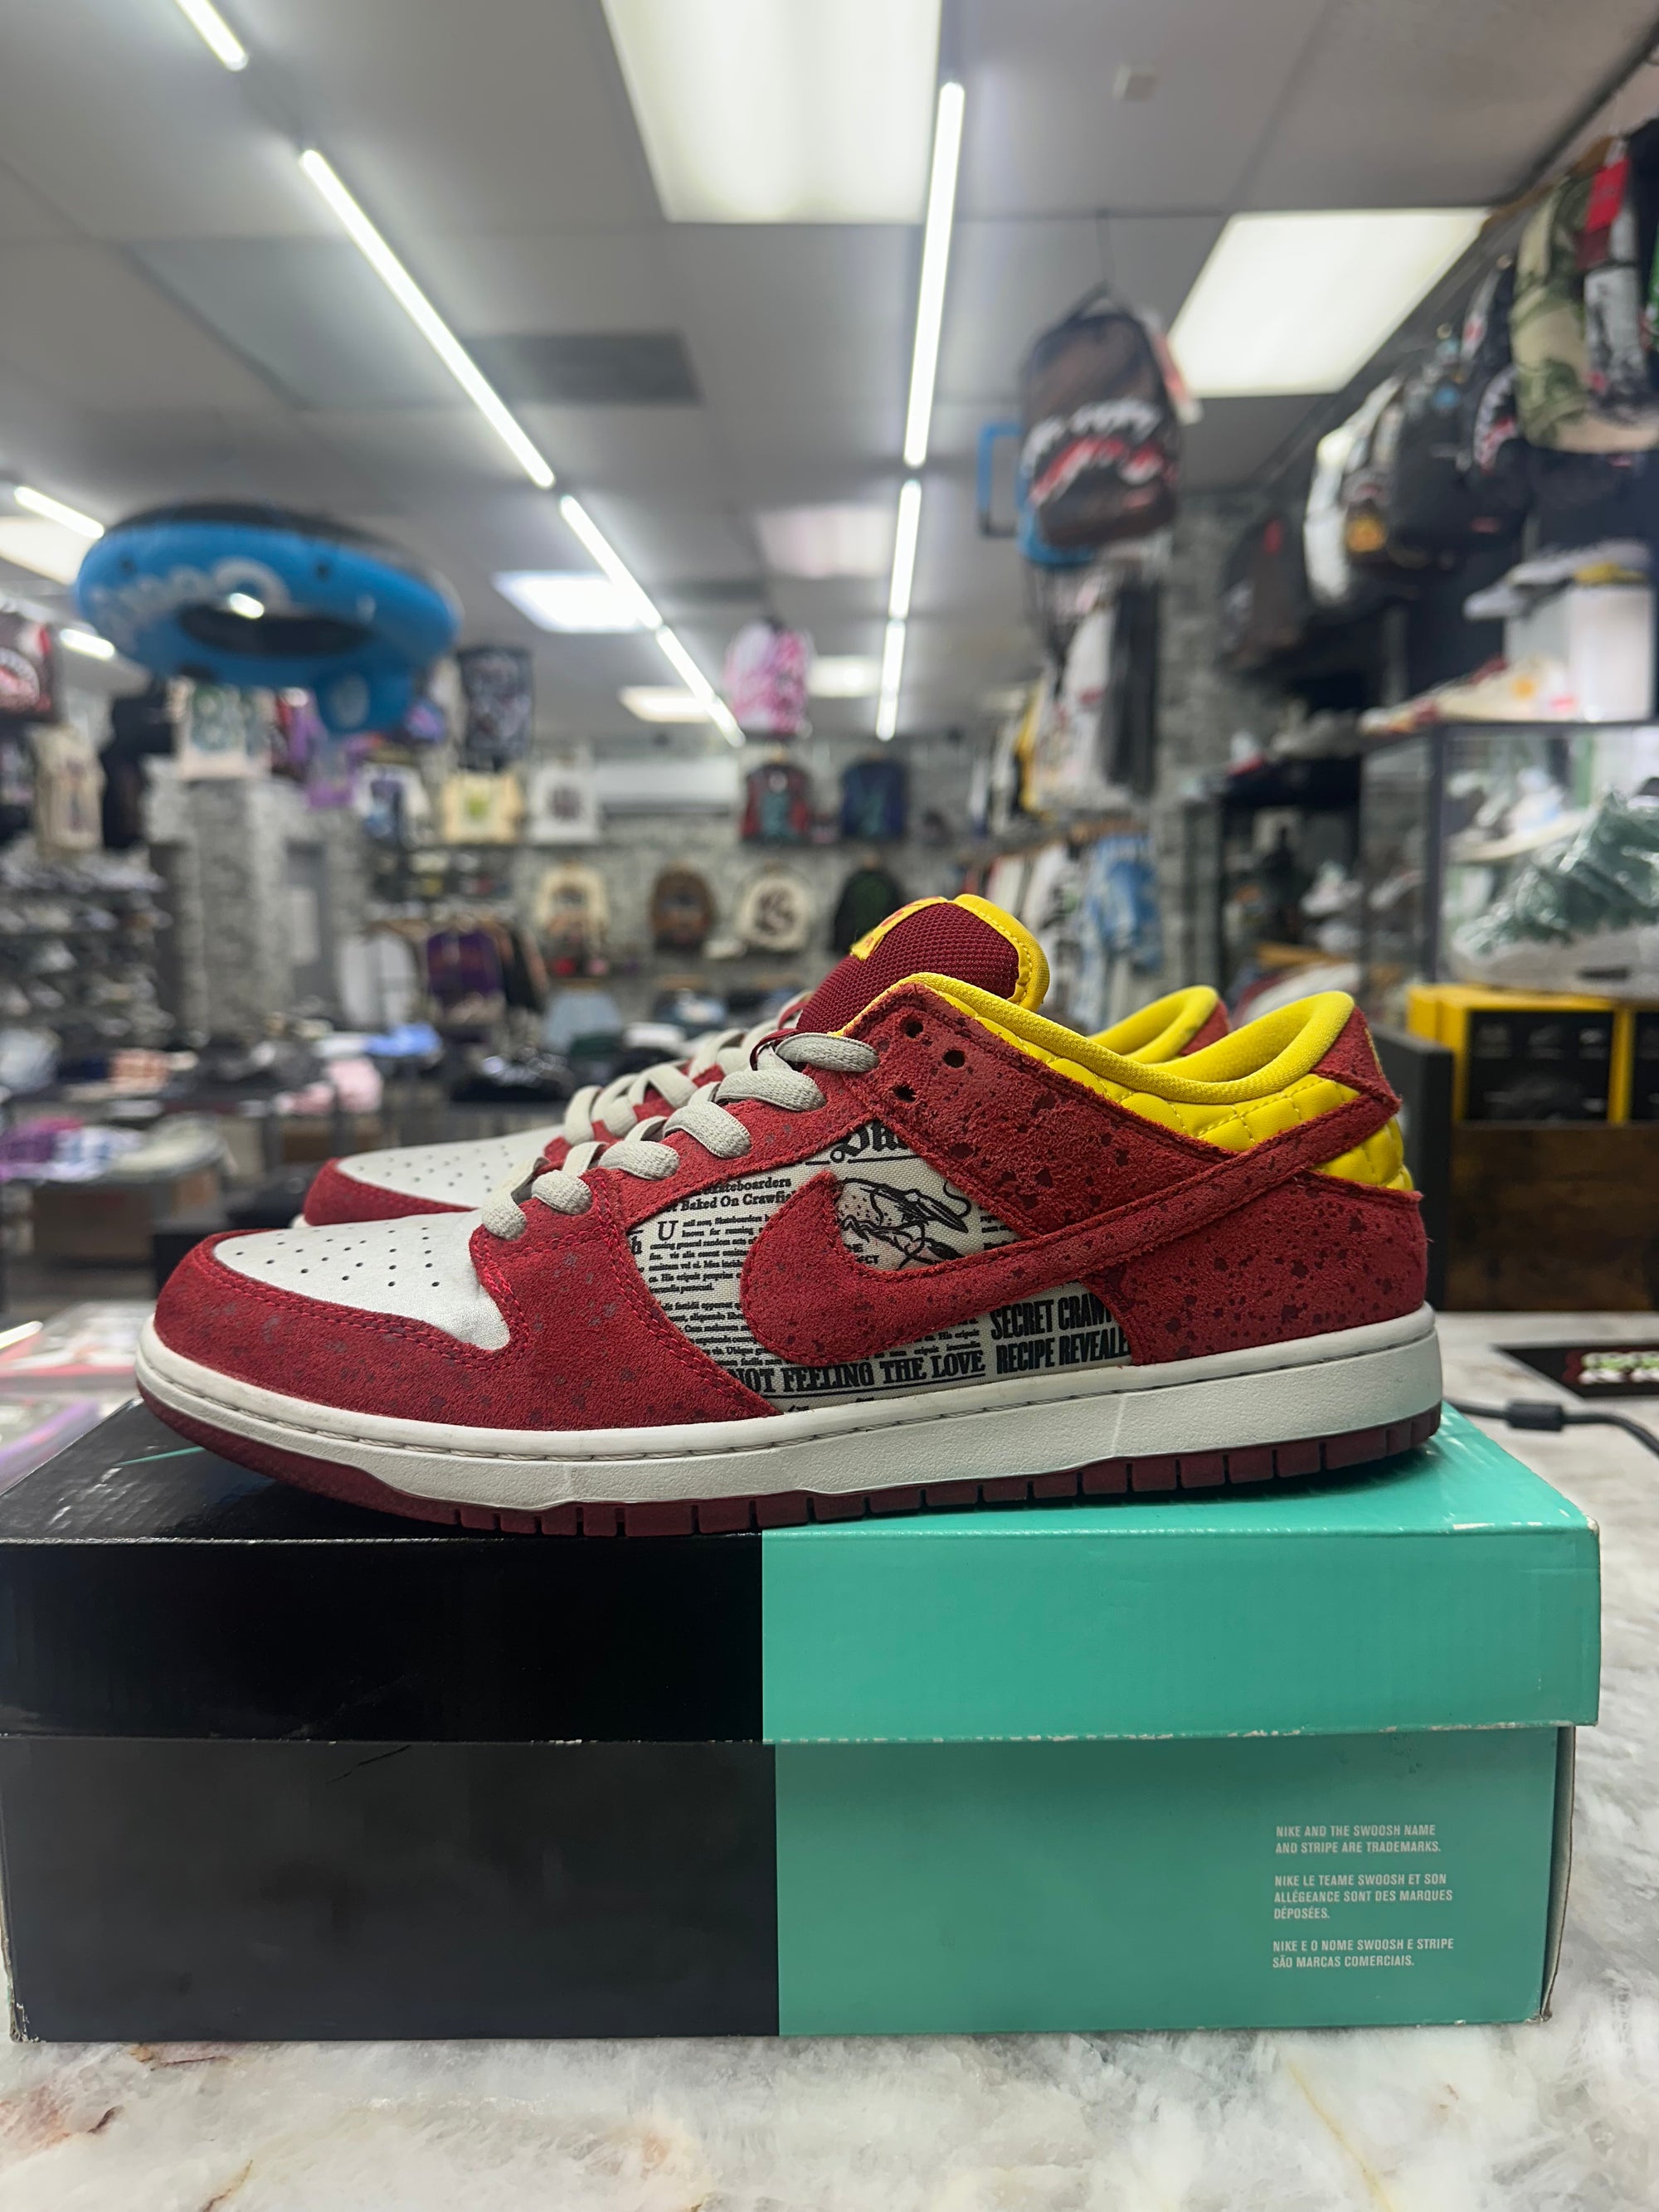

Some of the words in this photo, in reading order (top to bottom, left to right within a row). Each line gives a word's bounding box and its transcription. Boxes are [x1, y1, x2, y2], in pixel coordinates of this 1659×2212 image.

[680, 1196, 718, 1211] Baked
[720, 1195, 739, 1207] On
[742, 1190, 796, 1205] Crawfi
[990, 1299, 1054, 1339] SECRET
[996, 1338, 1055, 1374] RECIPE
[879, 1357, 927, 1383] THE
[930, 1350, 985, 1378] LOVE
[1276, 1826, 1301, 1837] NIKE
[1304, 1826, 1326, 1837] AND
[1330, 1826, 1350, 1836] THE
[1353, 1825, 1401, 1836] SWOOSH
[1404, 1825, 1436, 1835] NAME
[1276, 1843, 1297, 1854] AND
[1301, 1842, 1338, 1853] STRIPE
[1341, 1842, 1362, 1853] ARE
[1366, 1841, 1441, 1853] TRADEMARKS.
[1275, 1875, 1300, 1887] NIKE
[1303, 1875, 1315, 1886] LE
[1319, 1874, 1355, 1886] TEAME
[1358, 1874, 1405, 1885] SWOOSH
[1408, 1874, 1421, 1884] ET
[1424, 1874, 1447, 1884] SON
[1274, 1889, 1340, 1903] ALLÉGEANCE
[1344, 1891, 1371, 1902] SONT
[1375, 1890, 1396, 1902] DES
[1399, 1890, 1452, 1902] MARQUES
[1274, 1905, 1331, 1919] DÉPOSÉES.
[1272, 1940, 1297, 1952] NIKE
[1301, 1941, 1307, 1952] E
[1311, 1940, 1317, 1951] O
[1321, 1940, 1353, 1951] NOME
[1357, 1939, 1404, 1951] SWOOSH
[1407, 1939, 1413, 1949] E
[1417, 1938, 1454, 1949] STRIPE
[1272, 1955, 1292, 1968] SÃO
[1297, 1957, 1341, 1967] MARCAS
[1345, 1955, 1414, 1966] COMERCIAIS.
